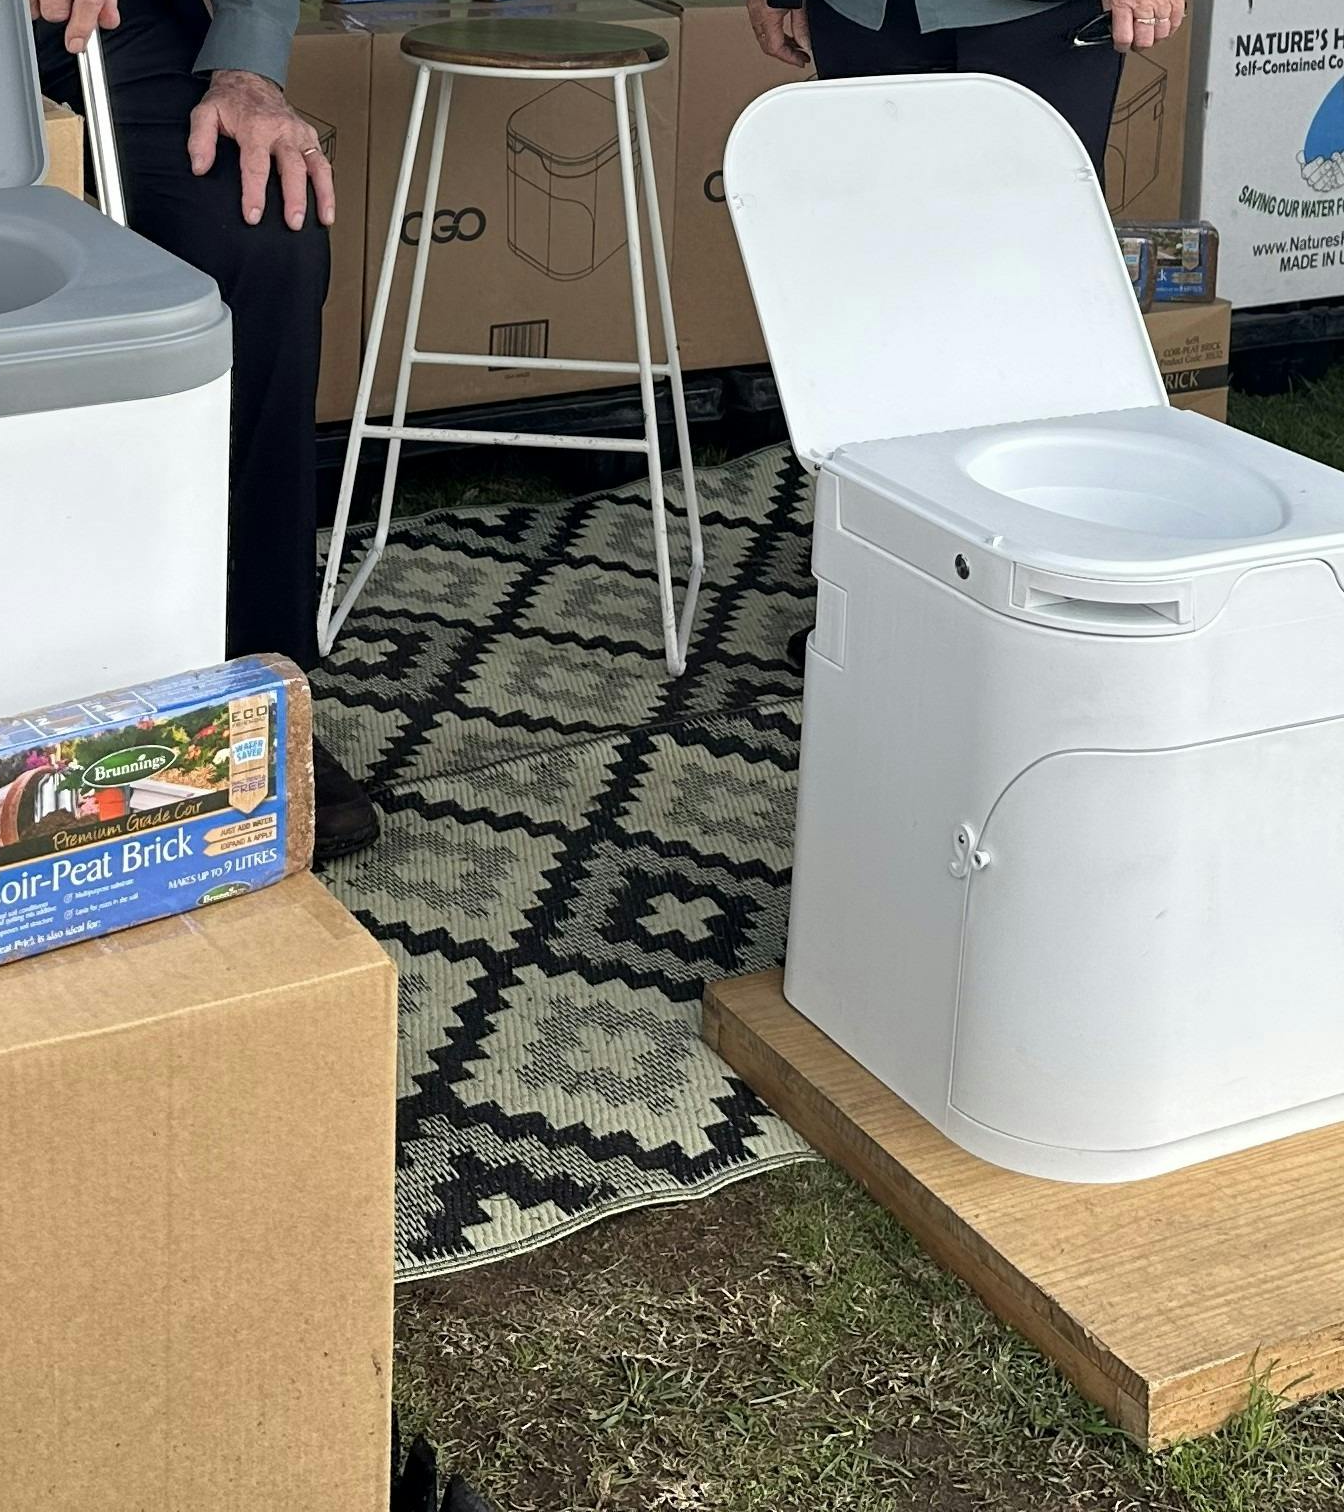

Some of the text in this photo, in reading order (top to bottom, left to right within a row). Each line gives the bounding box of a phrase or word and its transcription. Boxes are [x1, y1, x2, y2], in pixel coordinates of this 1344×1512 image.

[1235, 55, 1325, 77] Self-Contained
[1239, 185, 1276, 214] SAVING
[1277, 198, 1299, 217] OUR
[1301, 199, 1334, 218] WATER
[1280, 253, 1318, 272] MADE
[1322, 251, 1335, 267] IN
[232, 705, 267, 722] ECO
[95, 754, 165, 781] Brunnings
[53, 802, 202, 850] Premium Grade Coir
[123, 827, 193, 872] Brick
[224, 850, 277, 874] 9 LITRES
